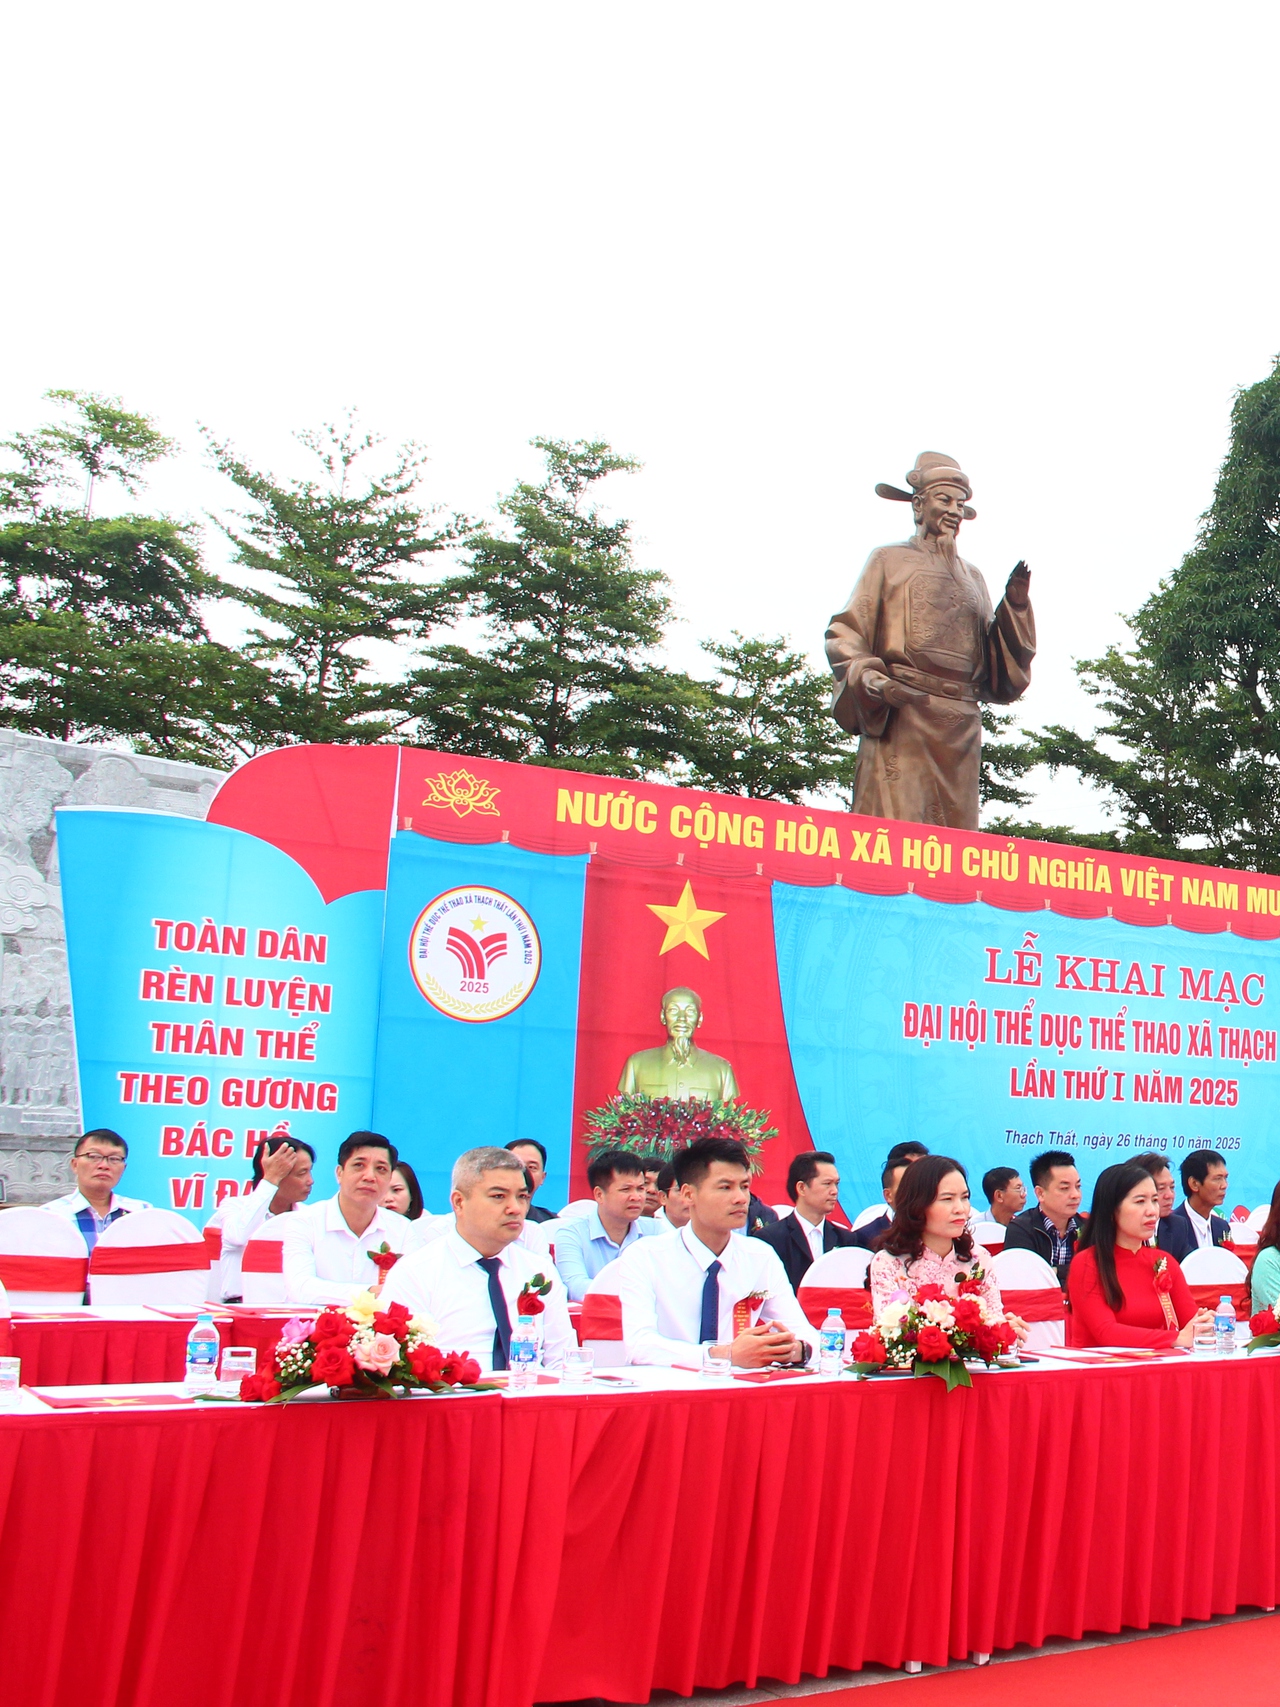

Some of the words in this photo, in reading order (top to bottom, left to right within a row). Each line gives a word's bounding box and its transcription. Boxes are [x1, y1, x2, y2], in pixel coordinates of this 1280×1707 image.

[556, 788, 658, 834] NƯỚC
[669, 802, 764, 849] CỘNG
[775, 815, 840, 859] HÒA
[850, 827, 892, 866] XÃ
[902, 834, 951, 878] HỘI
[961, 842, 1019, 882] CHỦ
[1028, 855, 1113, 894] NGHĨA
[1120, 866, 1175, 906] VIỆT
[1182, 876, 1239, 911] NAM
[154, 918, 246, 956] TOÀN
[257, 926, 327, 963] DÂN
[142, 966, 214, 1004] RÈN
[225, 976, 331, 1017] LUYỆN
[460, 980, 489, 993] 2025
[984, 931, 1042, 987] LỄ
[1055, 954, 1166, 997] KHAI
[1178, 966, 1265, 1013] MẠC
[151, 1020, 245, 1056] THÂN
[256, 1022, 319, 1061] THỂ
[903, 1002, 942, 1047] ĐẠI
[949, 1000, 987, 1050] HỘI
[994, 998, 1035, 1046] THỂ
[1039, 1013, 1083, 1056] DỤC
[1089, 1005, 1128, 1052] THỂ
[1132, 1020, 1181, 1055] THAO
[1187, 1019, 1213, 1057] XÃ
[1218, 1027, 1277, 1067] THẠCH
[120, 1072, 209, 1106] THEO
[221, 1077, 338, 1111] GƯƠNG
[1010, 1058, 1056, 1099] LẦN
[1063, 1066, 1109, 1101] THỨ
[1112, 1072, 1125, 1101] I
[1133, 1069, 1183, 1104] NĂM
[1189, 1078, 1239, 1107] 2025
[162, 1122, 234, 1158] BÁC
[1005, 1130, 1044, 1145] Thạch
[1048, 1129, 1079, 1147] Thất,
[1083, 1133, 1113, 1149] ngày
[1116, 1134, 1131, 1147] 26
[1134, 1134, 1167, 1151] tháng
[1172, 1135, 1185, 1149] 10
[1187, 1135, 1212, 1150] năm
[1215, 1137, 1241, 1150] 2025
[172, 1173, 207, 1208] VĨ
